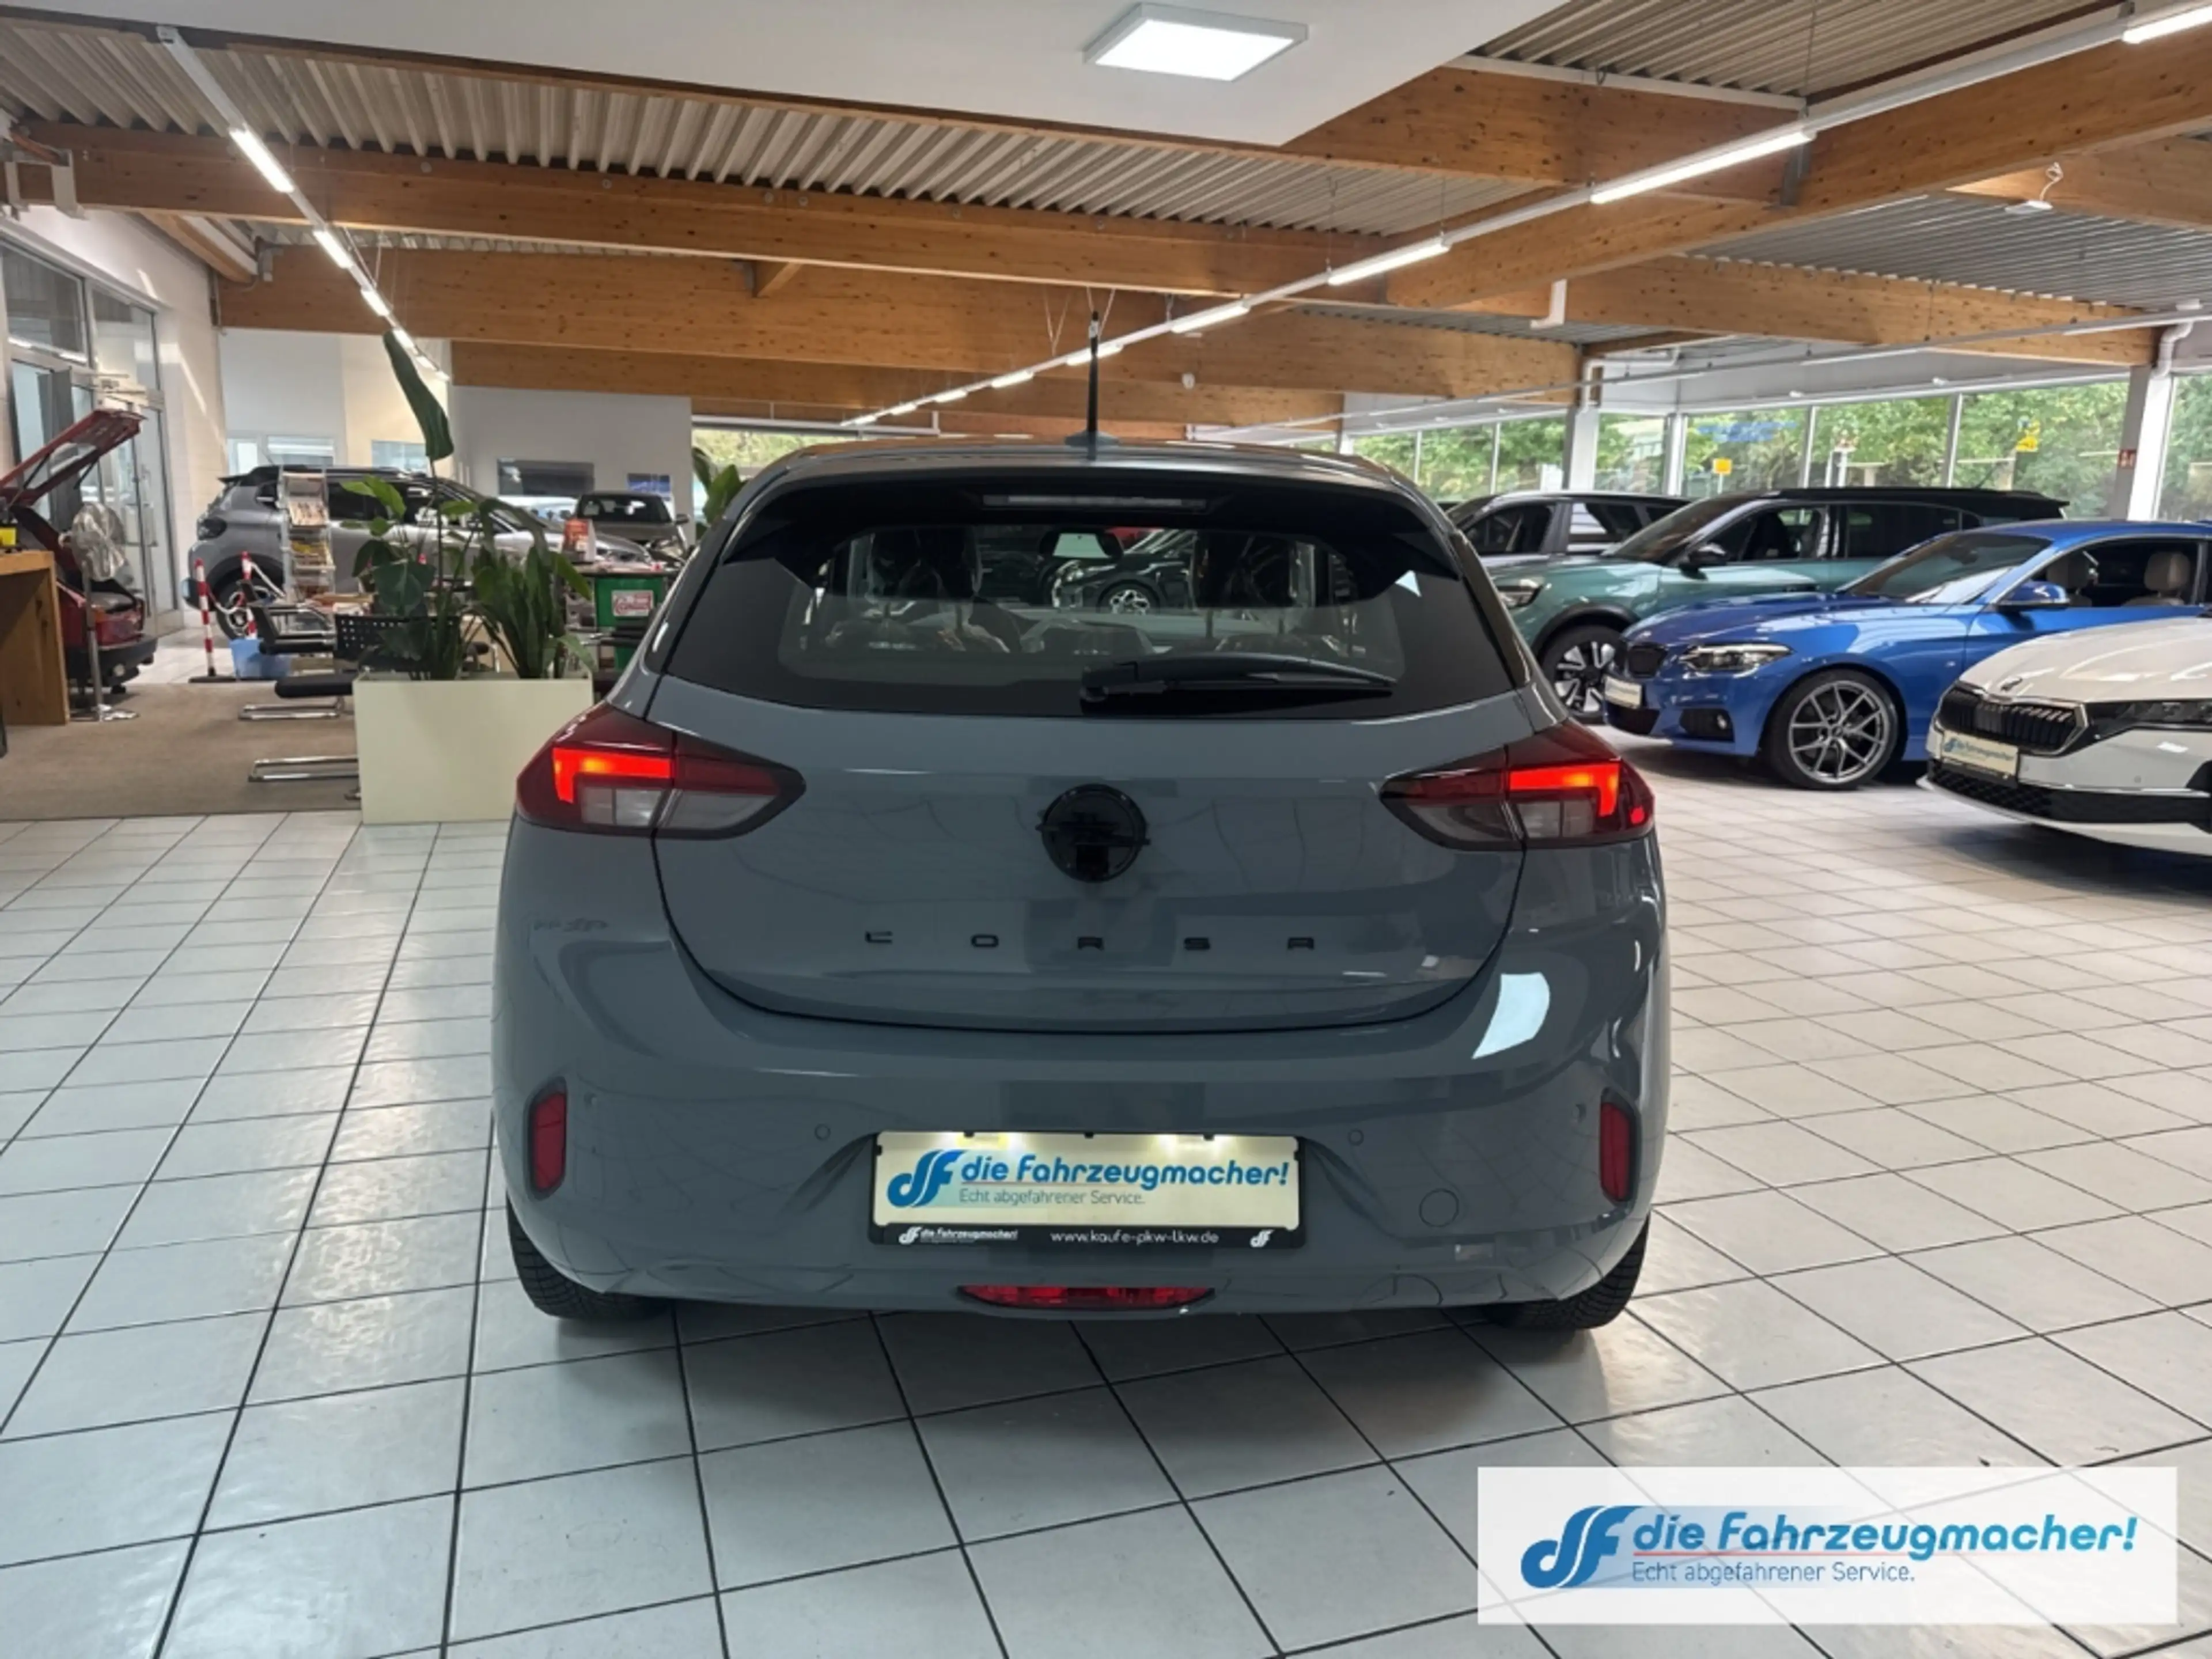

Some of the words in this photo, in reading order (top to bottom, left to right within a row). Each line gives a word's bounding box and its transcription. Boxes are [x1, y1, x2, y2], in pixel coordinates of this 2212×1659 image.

[864, 930, 1315, 950] CORSA
[961, 1156, 1009, 1181] die
[1017, 1154, 1289, 1191] Fahrzeugmacher!
[959, 1188, 990, 1202] Echt
[994, 1189, 1086, 1206] abgefahrener
[1090, 1190, 1146, 1205] Service.
